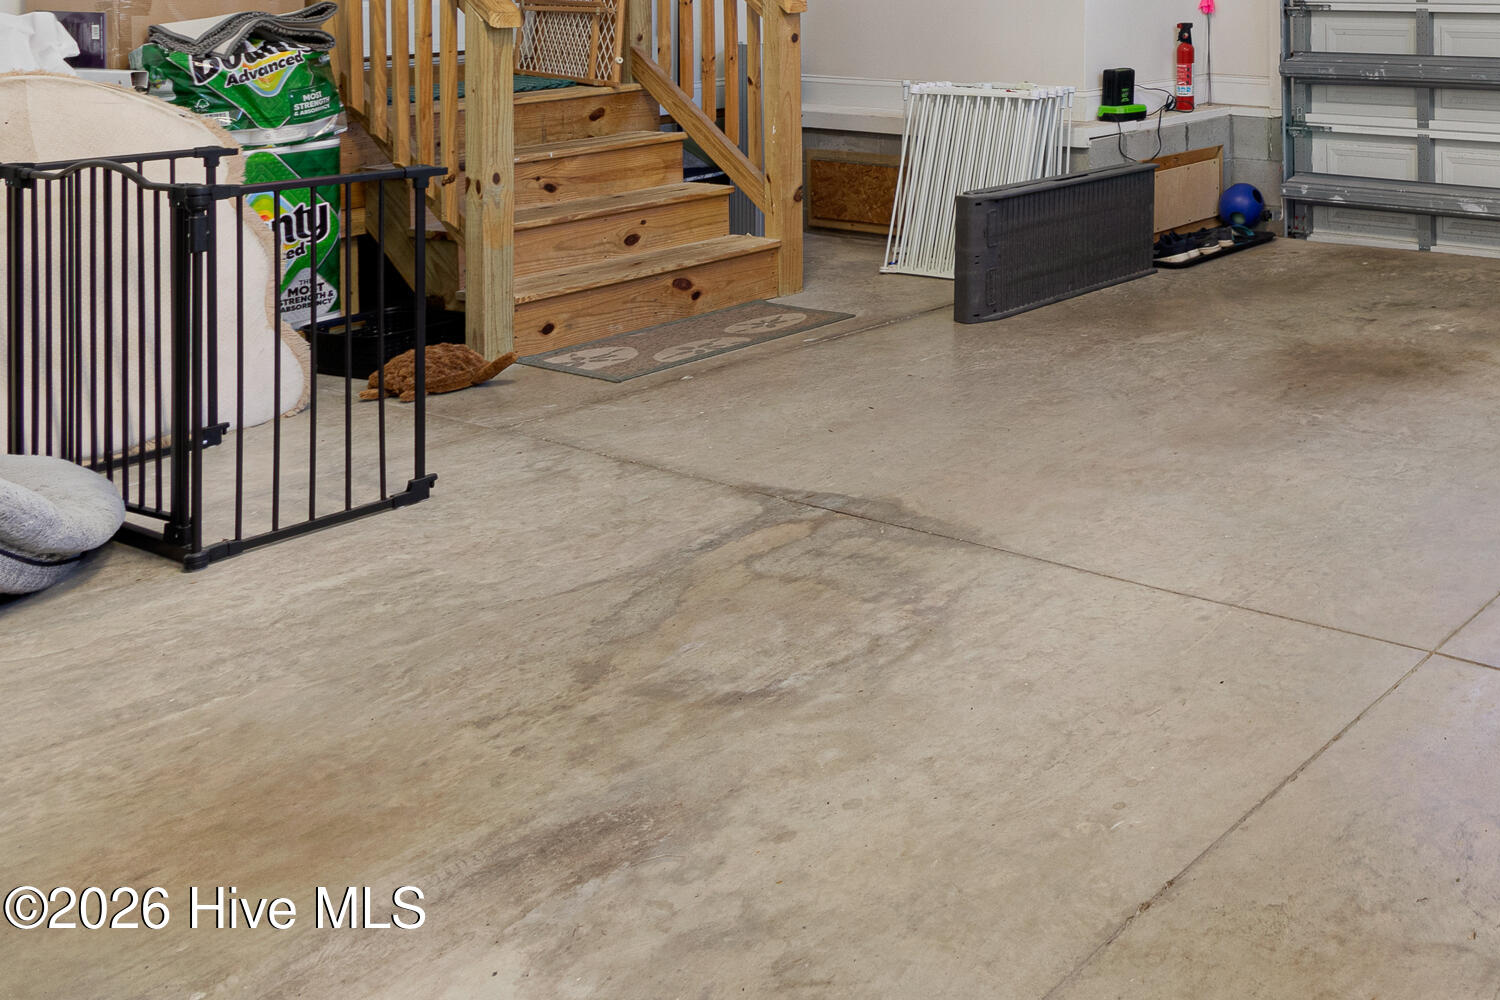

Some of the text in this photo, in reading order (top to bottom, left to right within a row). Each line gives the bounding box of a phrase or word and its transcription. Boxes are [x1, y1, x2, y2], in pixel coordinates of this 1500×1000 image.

[225, 50, 305, 87] Advanced
[288, 282, 325, 298] MOT
[280, 298, 333, 312] ABSORBNCY
